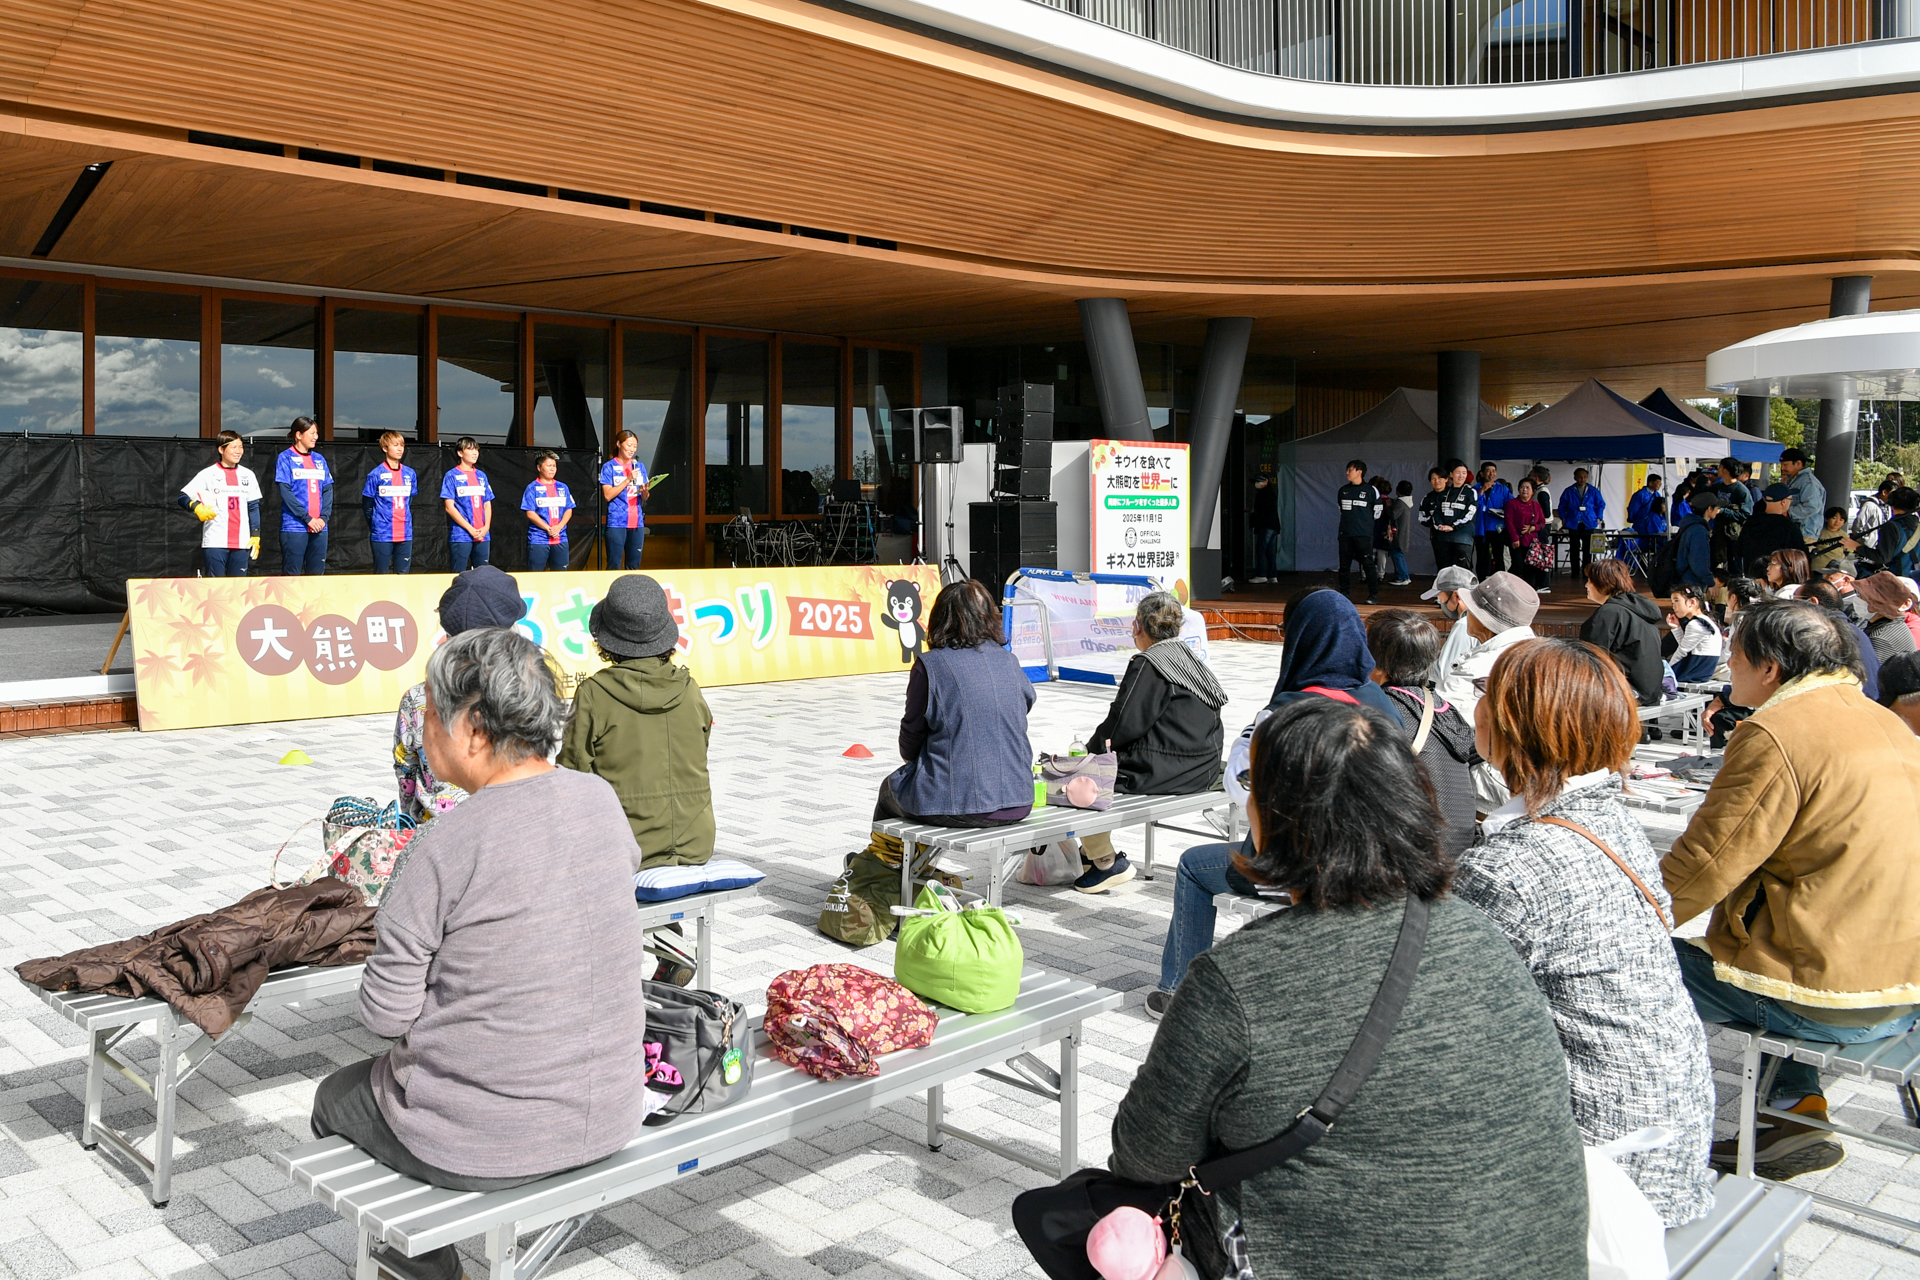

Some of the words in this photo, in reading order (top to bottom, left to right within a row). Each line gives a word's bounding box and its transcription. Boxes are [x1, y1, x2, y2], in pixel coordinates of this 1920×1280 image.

[1115, 455, 1171, 469] キウイを食べて
[310, 479, 317, 493] 5
[1107, 472, 1178, 490] 大熊町を世界一に
[228, 497, 240, 510] 31
[393, 496, 405, 509] 14
[474, 495, 480, 508] 9
[549, 507, 560, 519] 10
[1122, 513, 1163, 523] 2025年11月1日
[250, 617, 406, 673] 大熊町
[798, 601, 863, 634] 2025
